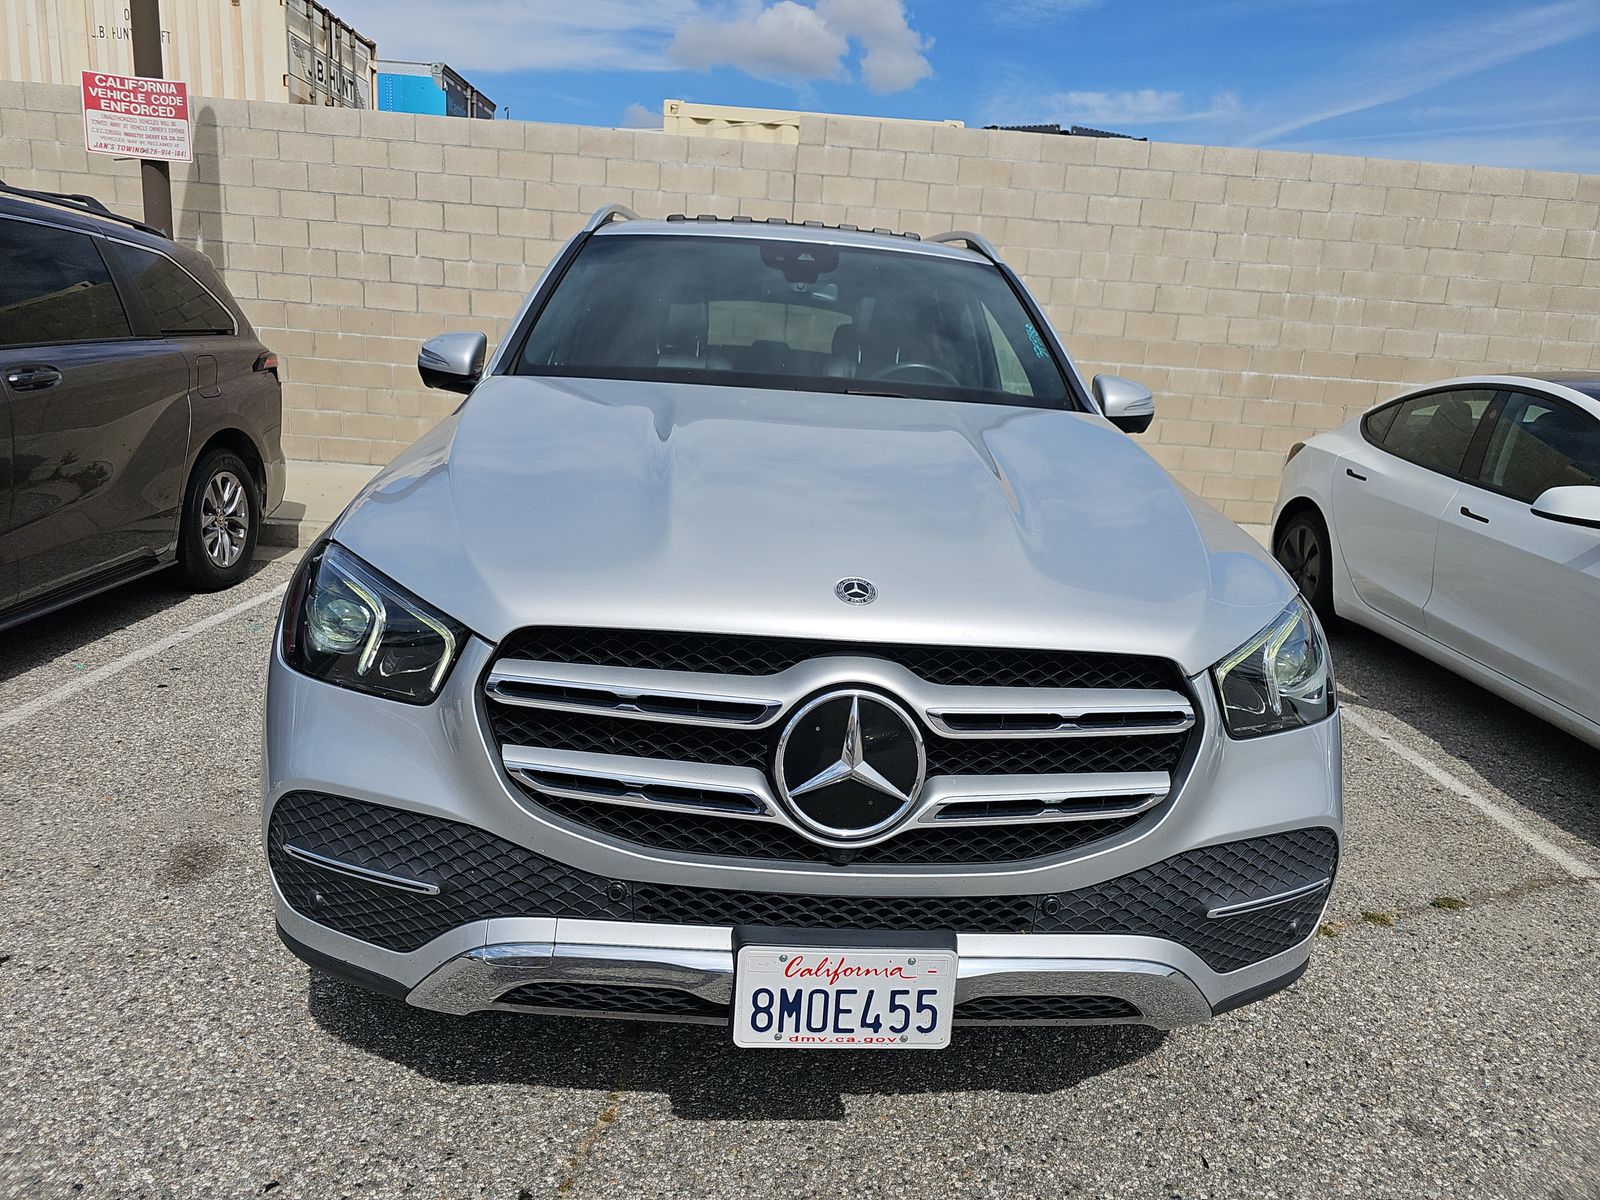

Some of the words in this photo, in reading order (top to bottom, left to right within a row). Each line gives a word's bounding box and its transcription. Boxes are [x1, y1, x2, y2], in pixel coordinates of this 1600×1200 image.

[112, 27, 132, 40] HUN
[95, 75, 177, 94] CALIFORNIA
[89, 87, 146, 103] VEHICLE
[152, 95, 183, 106] CODE
[100, 99, 175, 117] ENFORCED
[94, 142, 115, 150] JAN'S
[118, 144, 145, 154] TOWING
[146, 148, 186, 157] 626-914-1841
[784, 956, 916, 985] California
[750, 988, 938, 1034] 8MOE455
[788, 1035, 897, 1043] dmv.ca.gov
